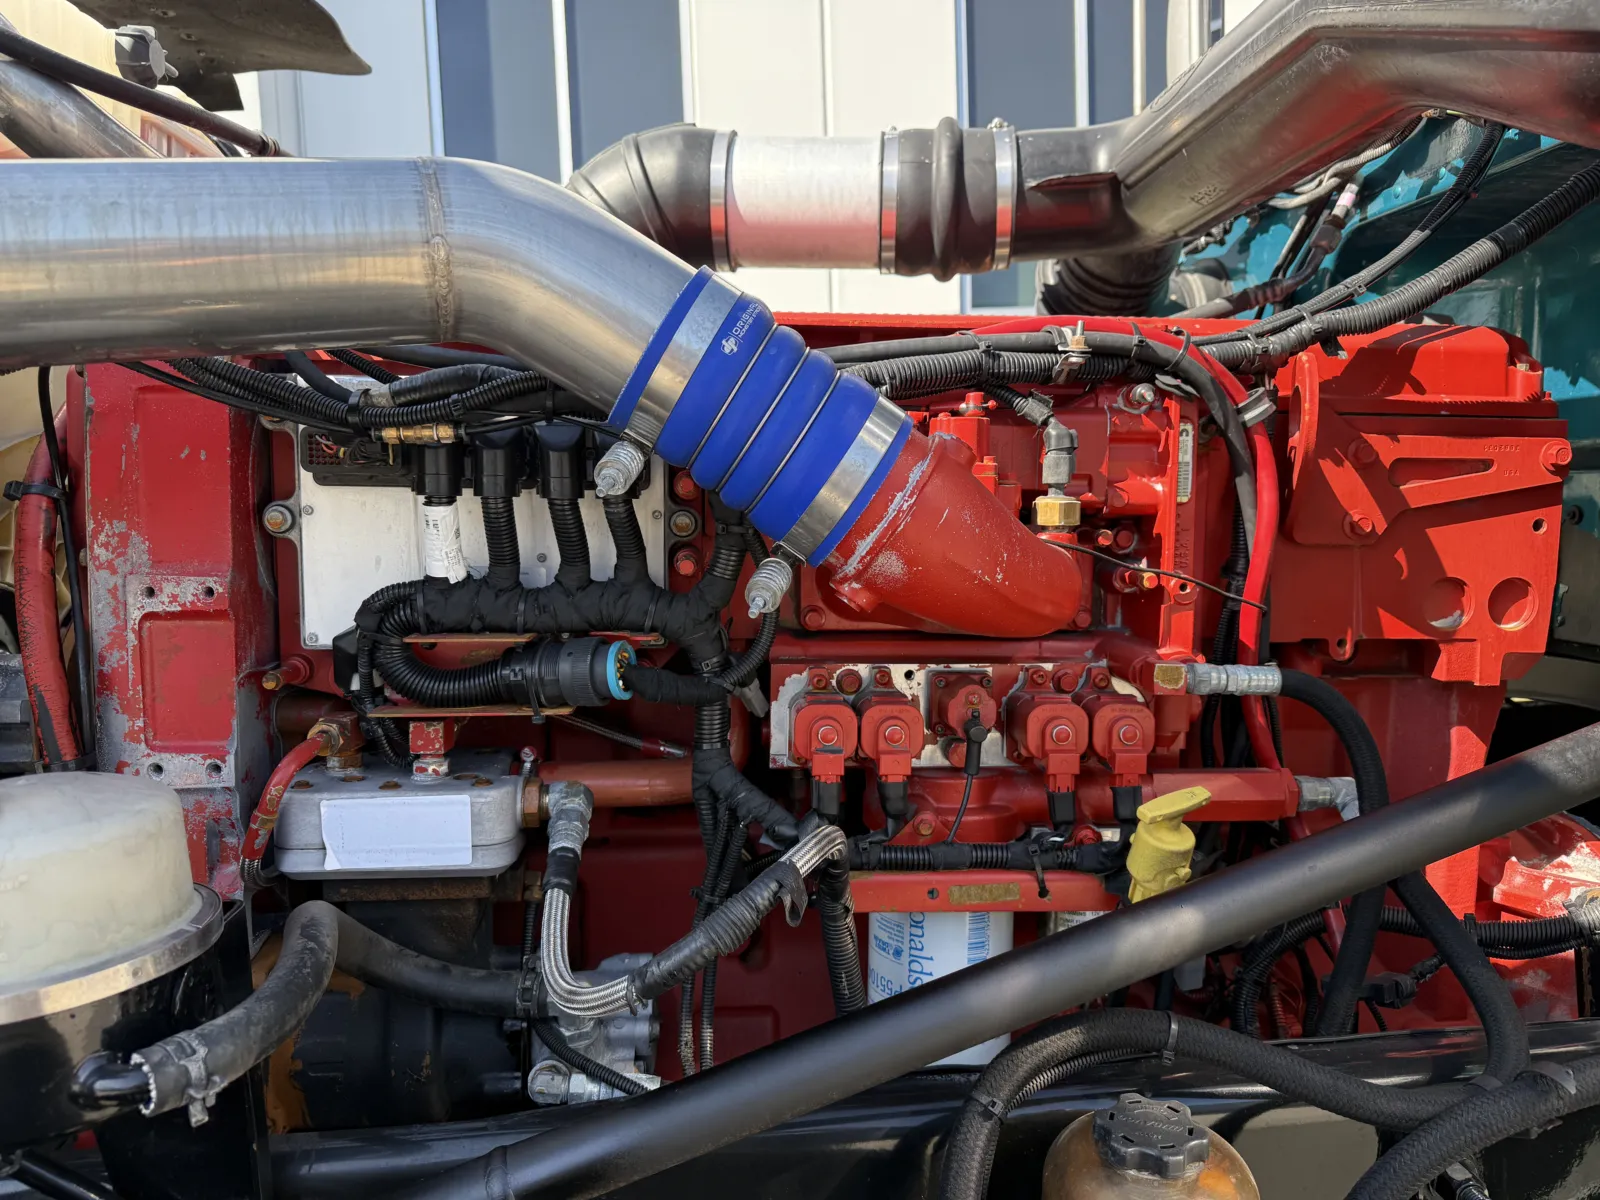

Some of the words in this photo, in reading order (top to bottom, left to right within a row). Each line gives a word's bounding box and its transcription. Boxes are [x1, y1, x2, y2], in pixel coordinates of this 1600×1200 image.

[732, 302, 758, 335] ORIGINAL
[1503, 469, 1520, 477] USA
[908, 912, 934, 988] onalds
